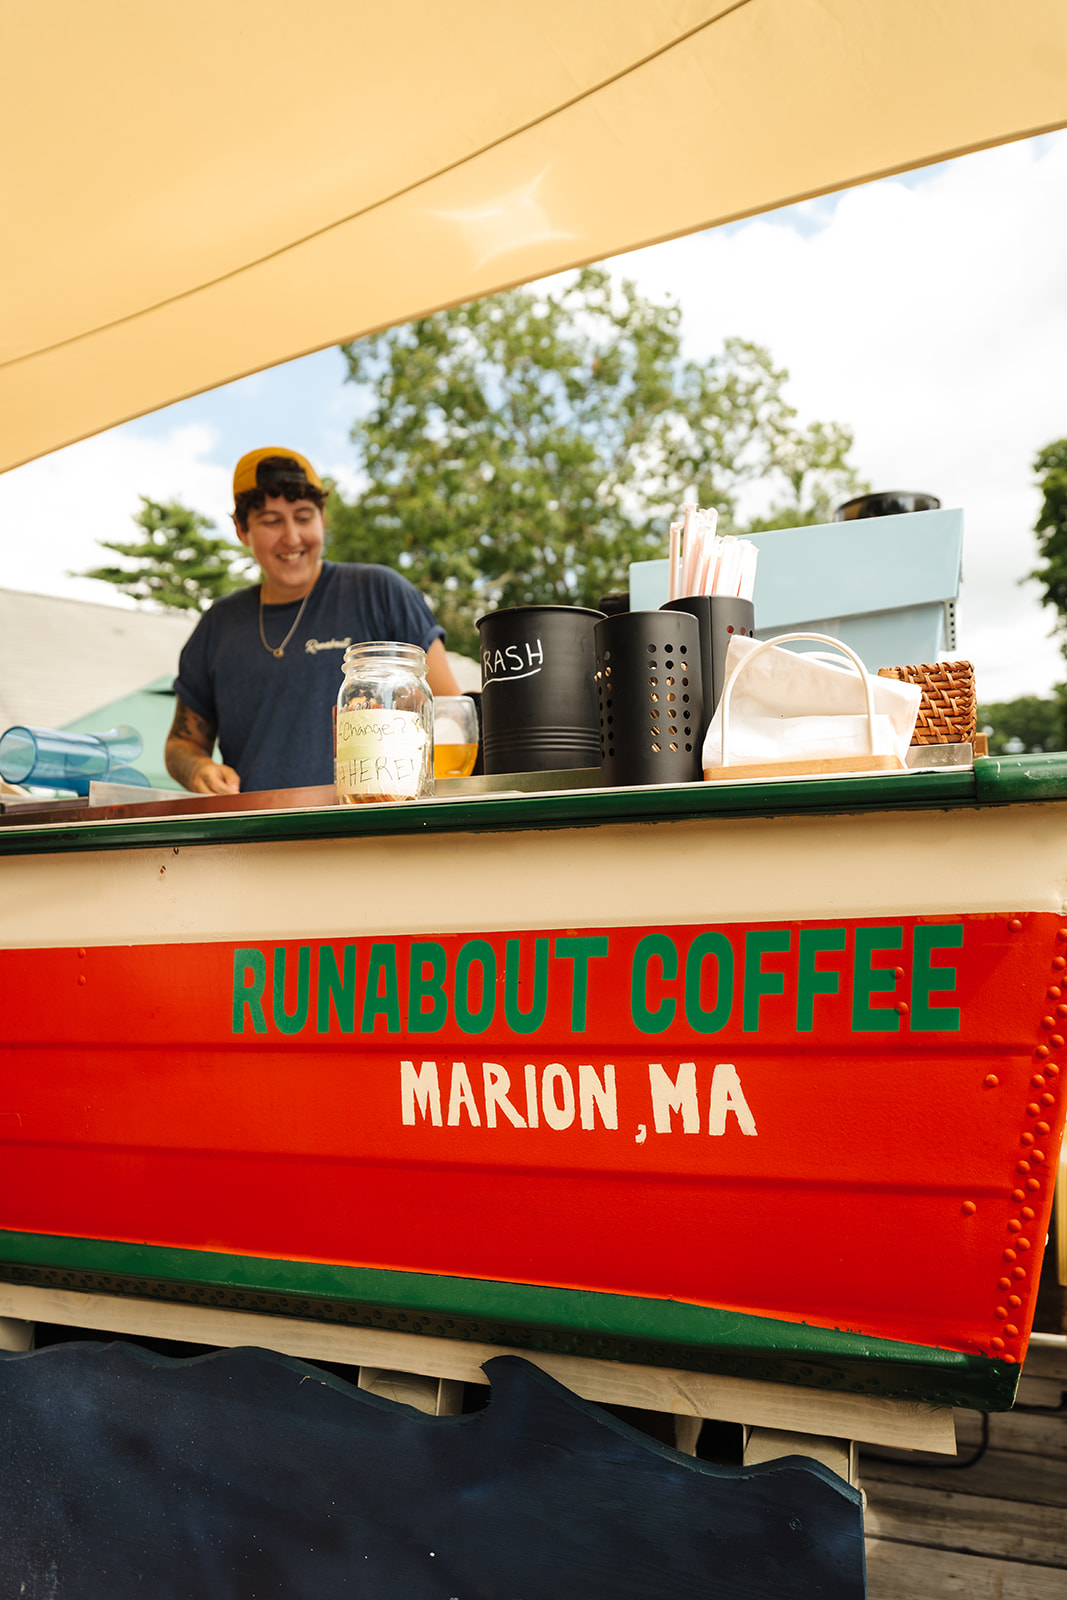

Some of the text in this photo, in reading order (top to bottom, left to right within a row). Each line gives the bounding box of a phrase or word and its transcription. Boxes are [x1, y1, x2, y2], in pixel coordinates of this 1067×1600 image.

[481, 639, 544, 678] RASH
[342, 716, 407, 742] Change?
[233, 925, 963, 1034] RUNABOUT COFFEE
[401, 1061, 618, 1130] MARION
